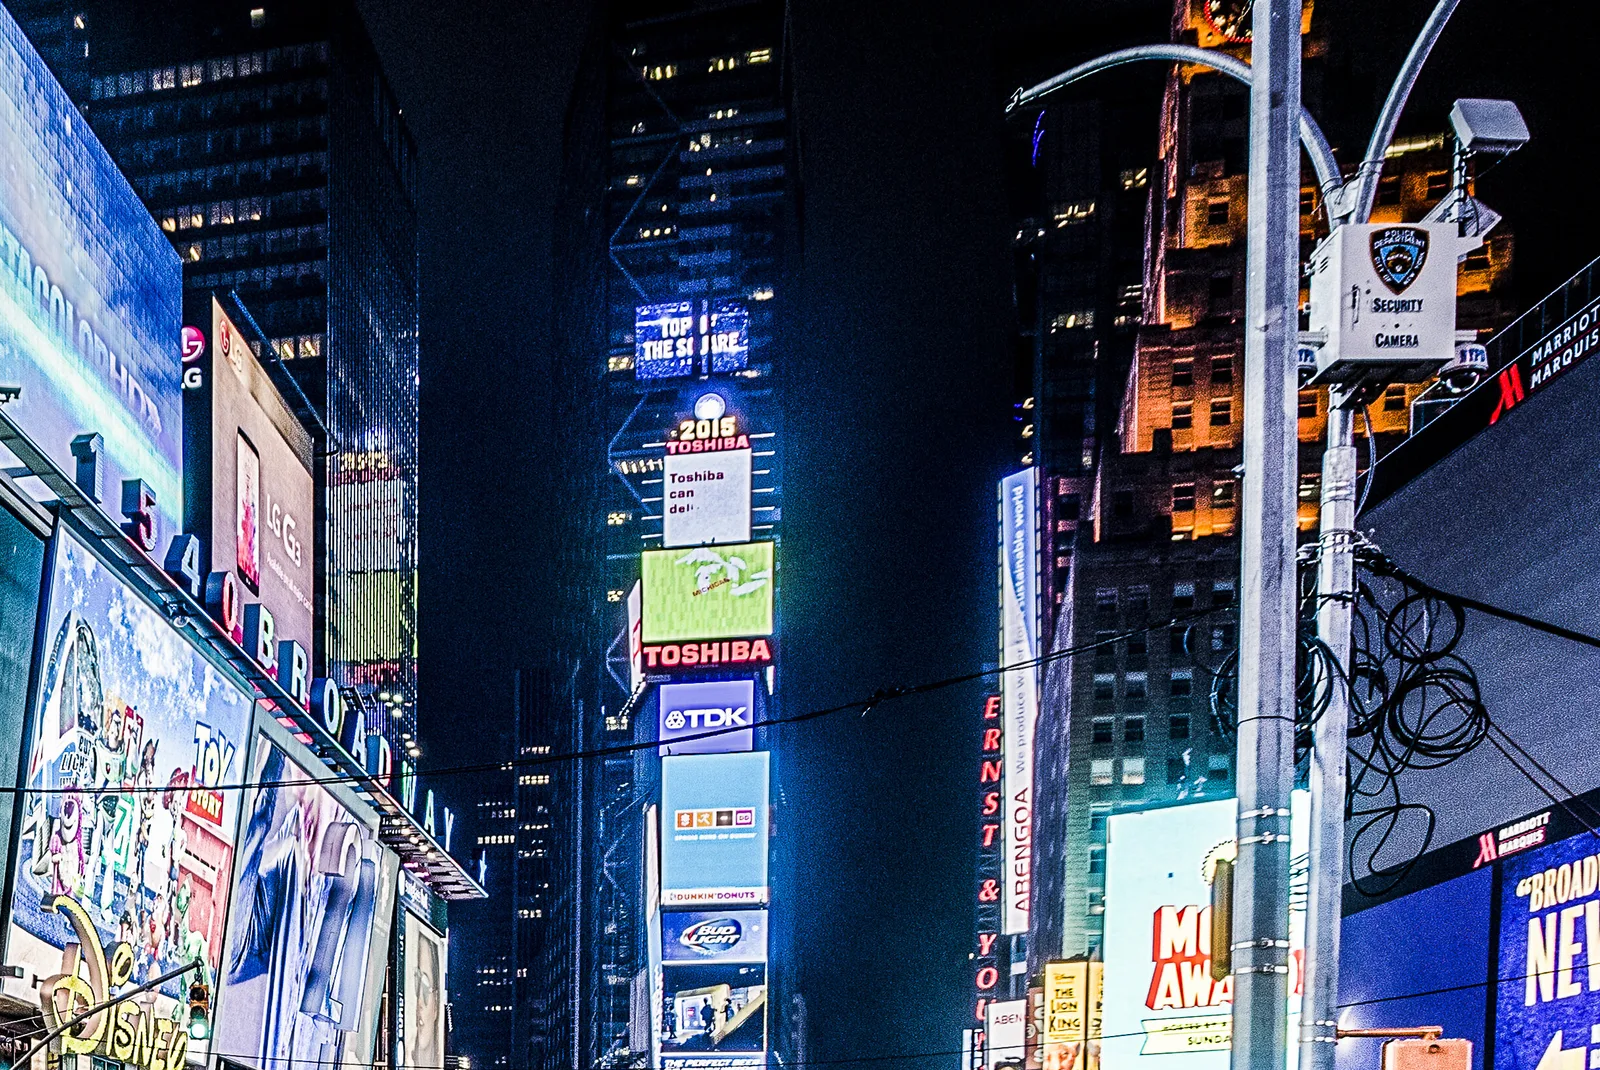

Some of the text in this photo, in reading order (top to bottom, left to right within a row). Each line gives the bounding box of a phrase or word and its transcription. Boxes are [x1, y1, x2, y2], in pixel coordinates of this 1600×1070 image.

[1373, 235, 1426, 249] DEPARTMENT
[1385, 230, 1416, 238] POLICE
[1373, 298, 1424, 313] SECURITY
[660, 316, 693, 338] TOP
[642, 339, 674, 360] THE
[1375, 333, 1419, 347] CAMERA
[229, 333, 243, 373] LG
[1530, 328, 1600, 390] MARQUIS
[182, 367, 202, 389] G
[679, 415, 736, 440] 2015
[665, 434, 750, 455] TOSHIBA
[669, 469, 725, 484] Toshiba
[669, 488, 695, 499] can
[1013, 485, 1026, 528] world
[266, 494, 302, 569] LG G3
[691, 576, 731, 598] MICHIGAN
[71, 432, 455, 851] 1540 BROADWAY
[642, 639, 772, 667] TOSHIBA
[684, 707, 747, 729] TDK
[1015, 706, 1029, 750] produce
[194, 720, 236, 788] TOY
[977, 697, 1002, 901] ERNST &
[1014, 787, 1031, 911] ABENGOA
[691, 934, 741, 945] LIGHT
[699, 925, 737, 935] BUD
[1055, 987, 1074, 998] THE
[1051, 999, 1078, 1014] LION
[1048, 1015, 1081, 1033] KING
[685, 1058, 732, 1067] PERFECT
